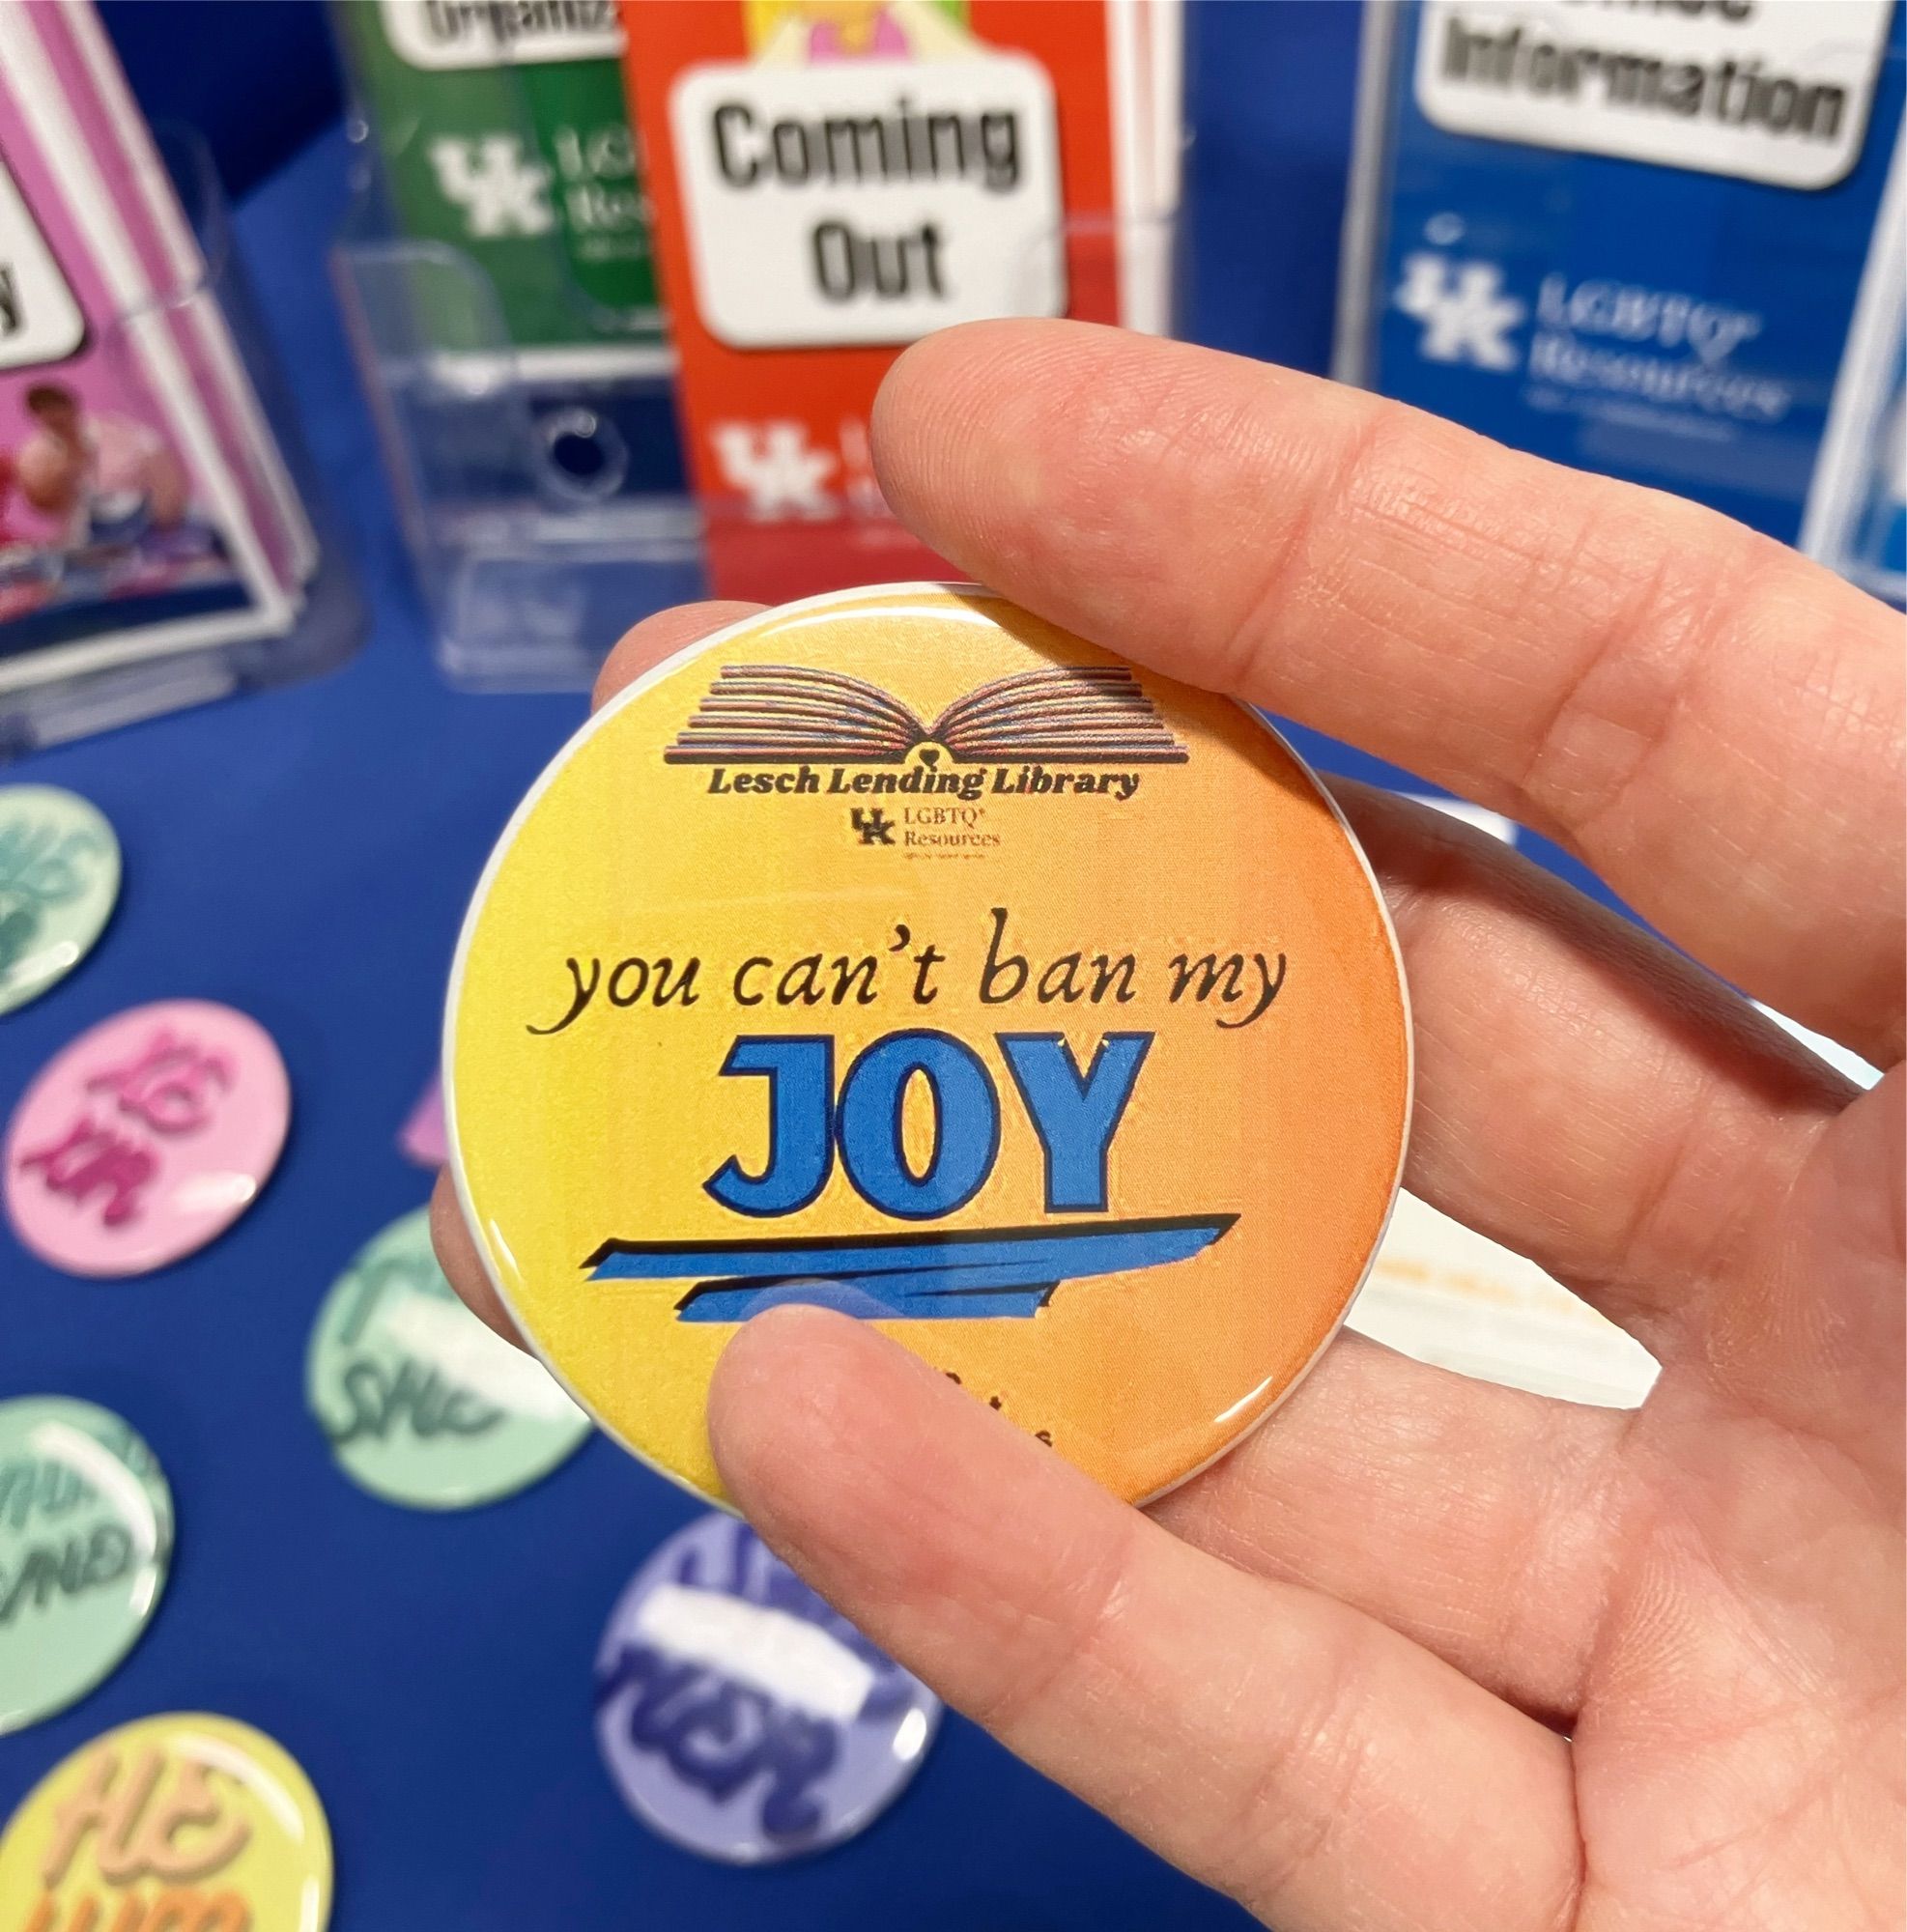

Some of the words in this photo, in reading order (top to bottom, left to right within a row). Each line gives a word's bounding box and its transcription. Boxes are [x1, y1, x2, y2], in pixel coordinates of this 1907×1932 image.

[1442, 15, 1846, 141] Information
[712, 99, 1022, 188] Coming
[811, 220, 946, 301] Out
[708, 766, 819, 795] Lesch
[827, 766, 985, 801] Lending
[991, 766, 1141, 801] Library
[903, 830, 1001, 847] Resources
[526, 955, 701, 1035] you
[733, 924, 946, 1007] can't
[979, 907, 1138, 1005] ban
[1168, 952, 1288, 1029] my
[702, 1028, 1156, 1220] JOY
